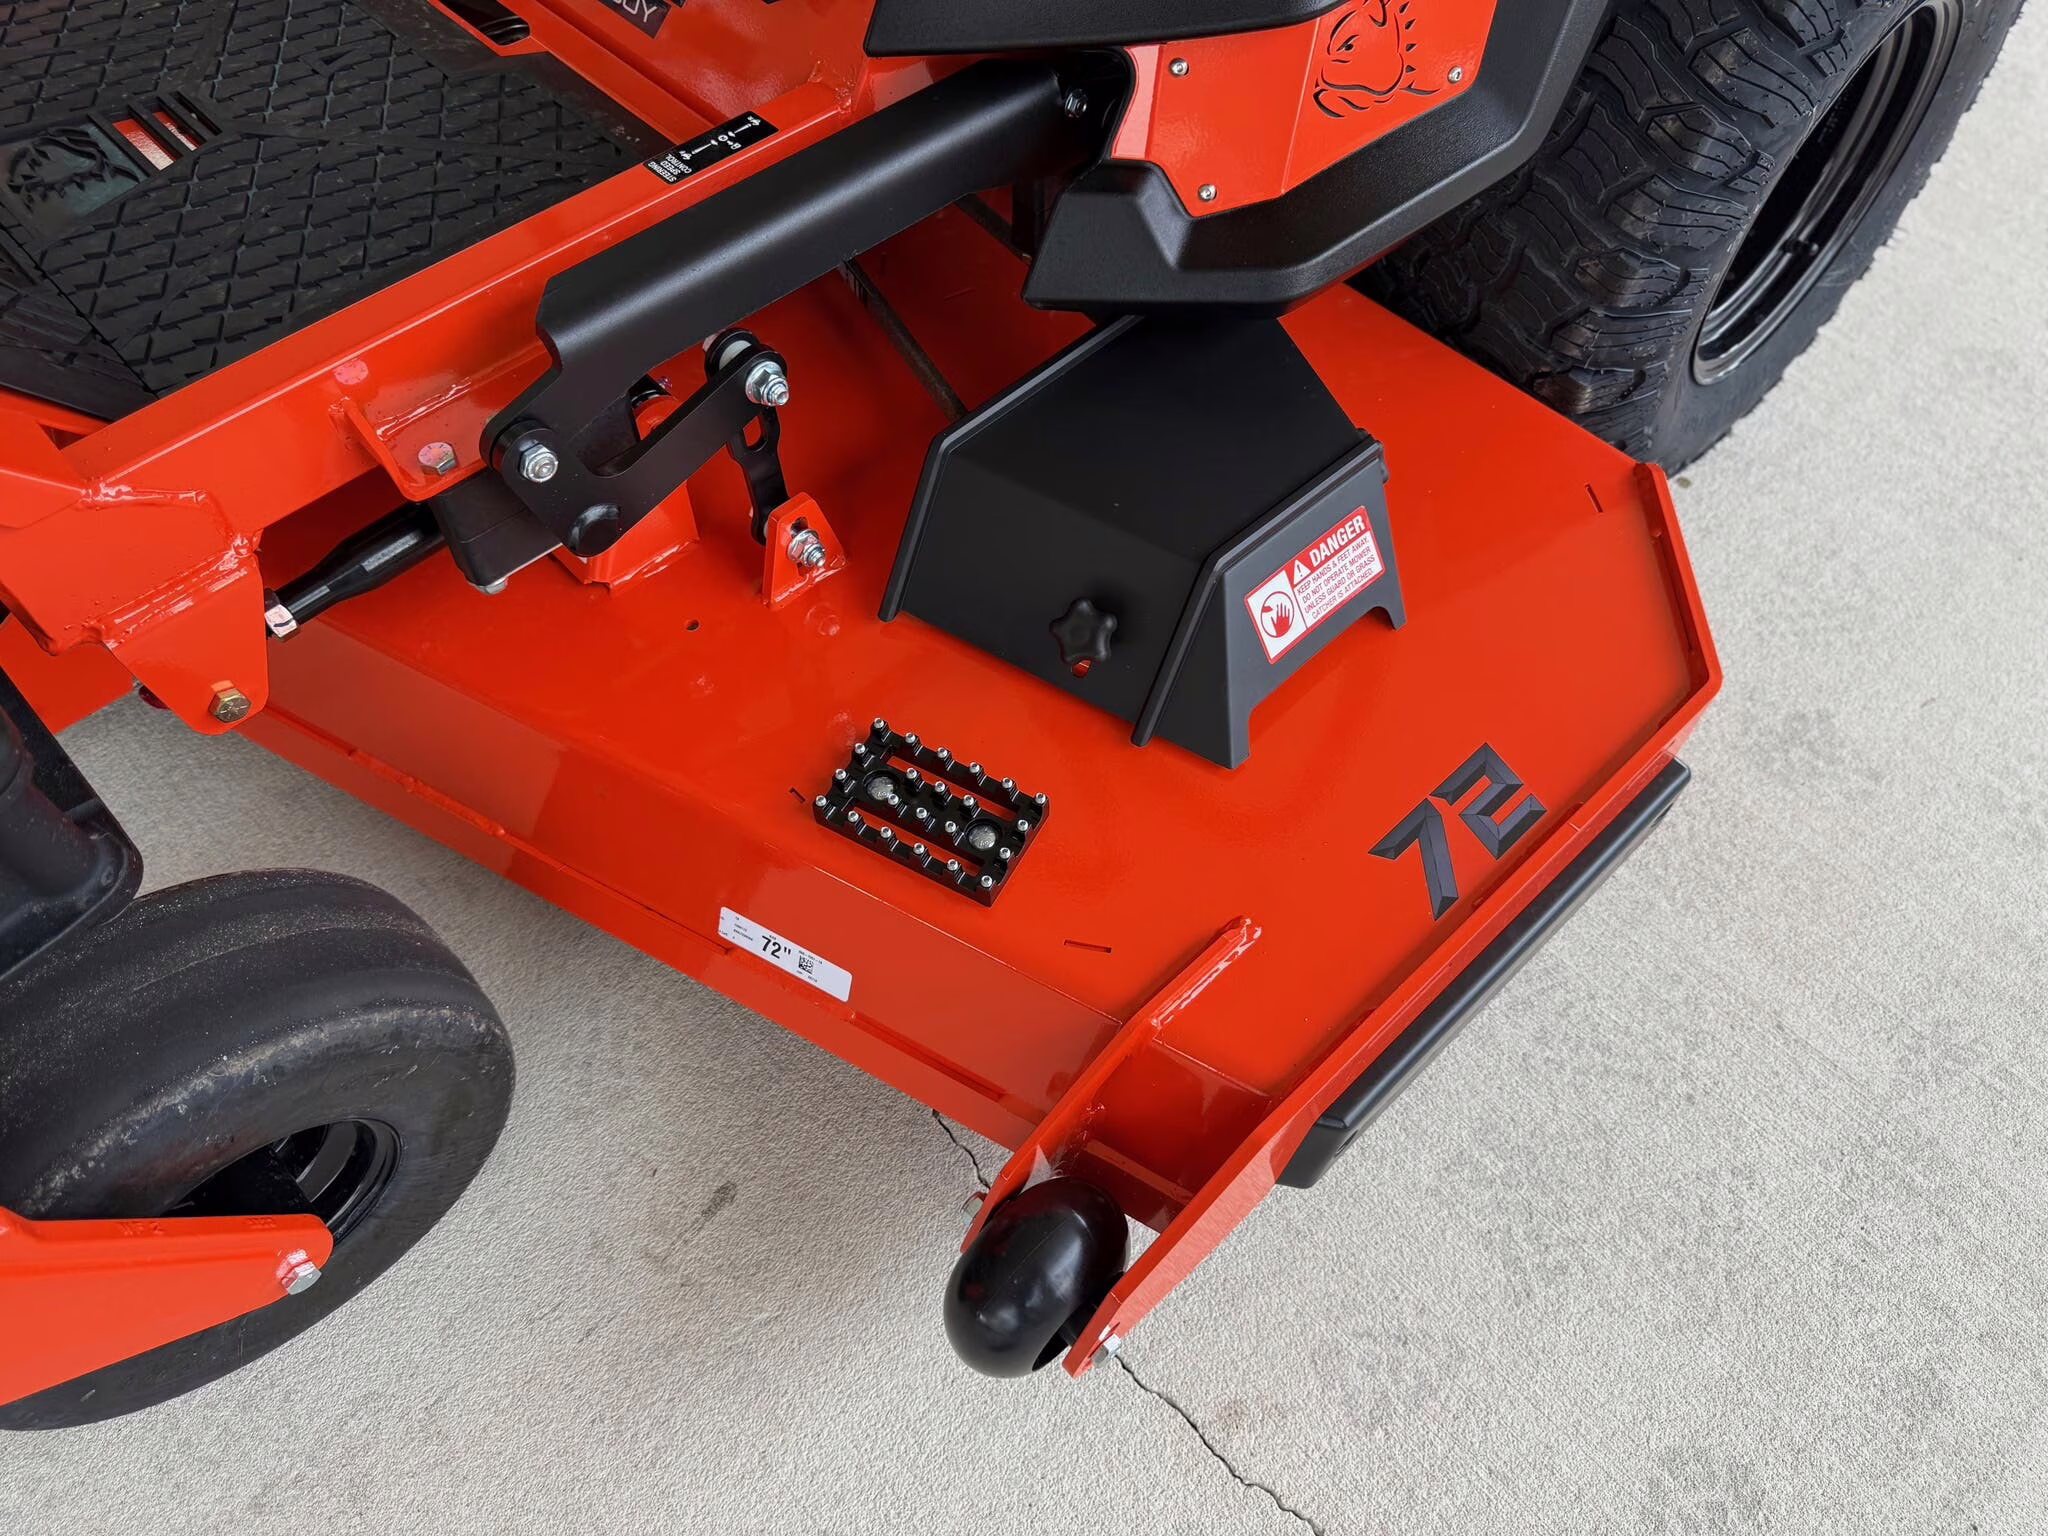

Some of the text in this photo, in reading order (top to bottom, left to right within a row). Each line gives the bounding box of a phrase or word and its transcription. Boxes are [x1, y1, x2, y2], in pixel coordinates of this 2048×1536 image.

[648, 161, 677, 182] STEERING
[660, 160, 681, 175] SPEED
[665, 153, 692, 174] CONTROL
[1309, 515, 1366, 567] DANGER
[1297, 580, 1311, 596] KEEP
[1312, 564, 1332, 584] HANDS
[1337, 549, 1351, 564] FEET
[1302, 546, 1371, 604] DO NOT OPERATE MOWER
[1304, 554, 1375, 614] UNLESS GUARD OR GRASS
[1312, 595, 1337, 619] CATCHER
[1337, 589, 1344, 598] IS
[1368, 742, 1547, 921] 72
